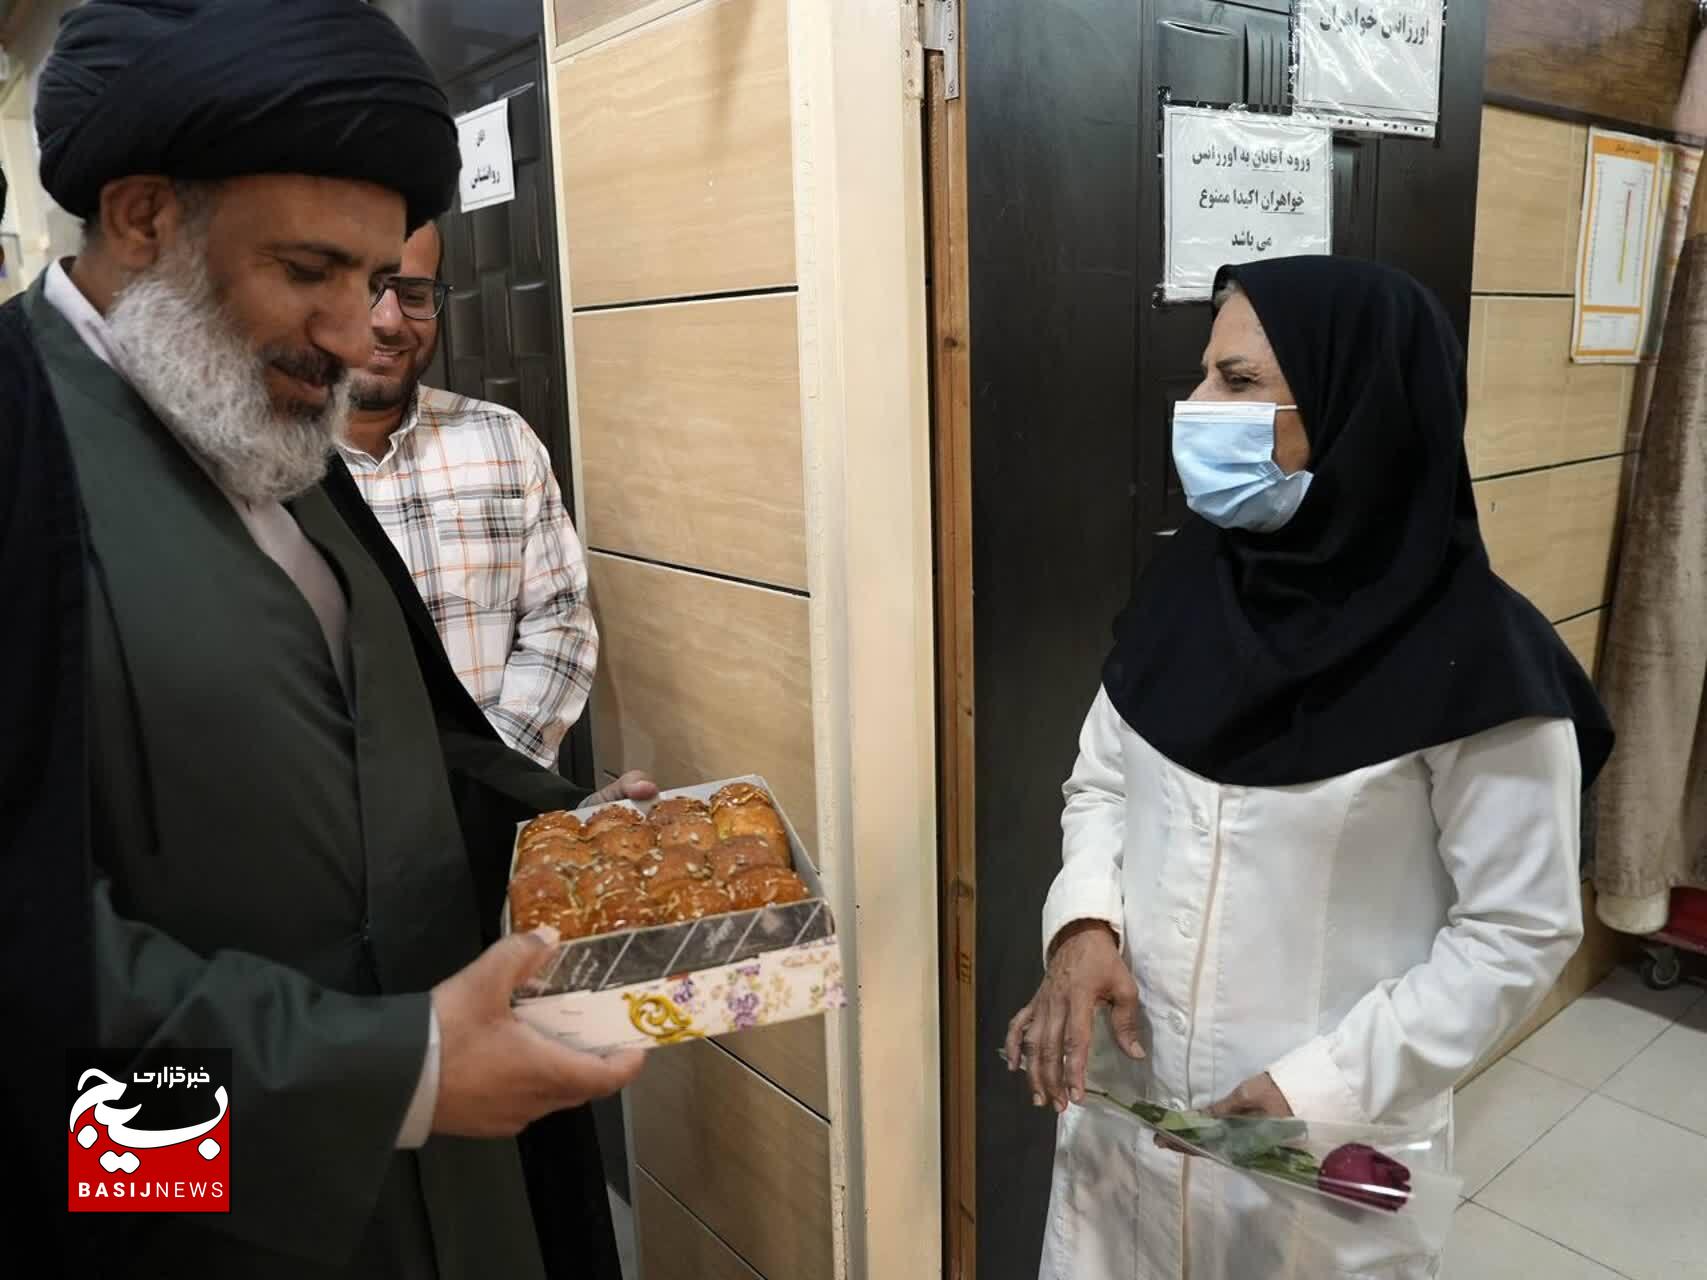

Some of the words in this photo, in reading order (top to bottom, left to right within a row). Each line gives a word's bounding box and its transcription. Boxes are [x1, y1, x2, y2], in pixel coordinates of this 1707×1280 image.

[1319, 5, 1377, 36] خواهران
[1381, 11, 1430, 45] اورژانس
[1239, 150, 1250, 168] به
[1286, 155, 1311, 172] ورود
[1199, 187, 1231, 209] ممنوع
[1261, 188, 1305, 212] خواهران
[1231, 230, 1255, 251] باشد
[1255, 235, 1272, 252] می
